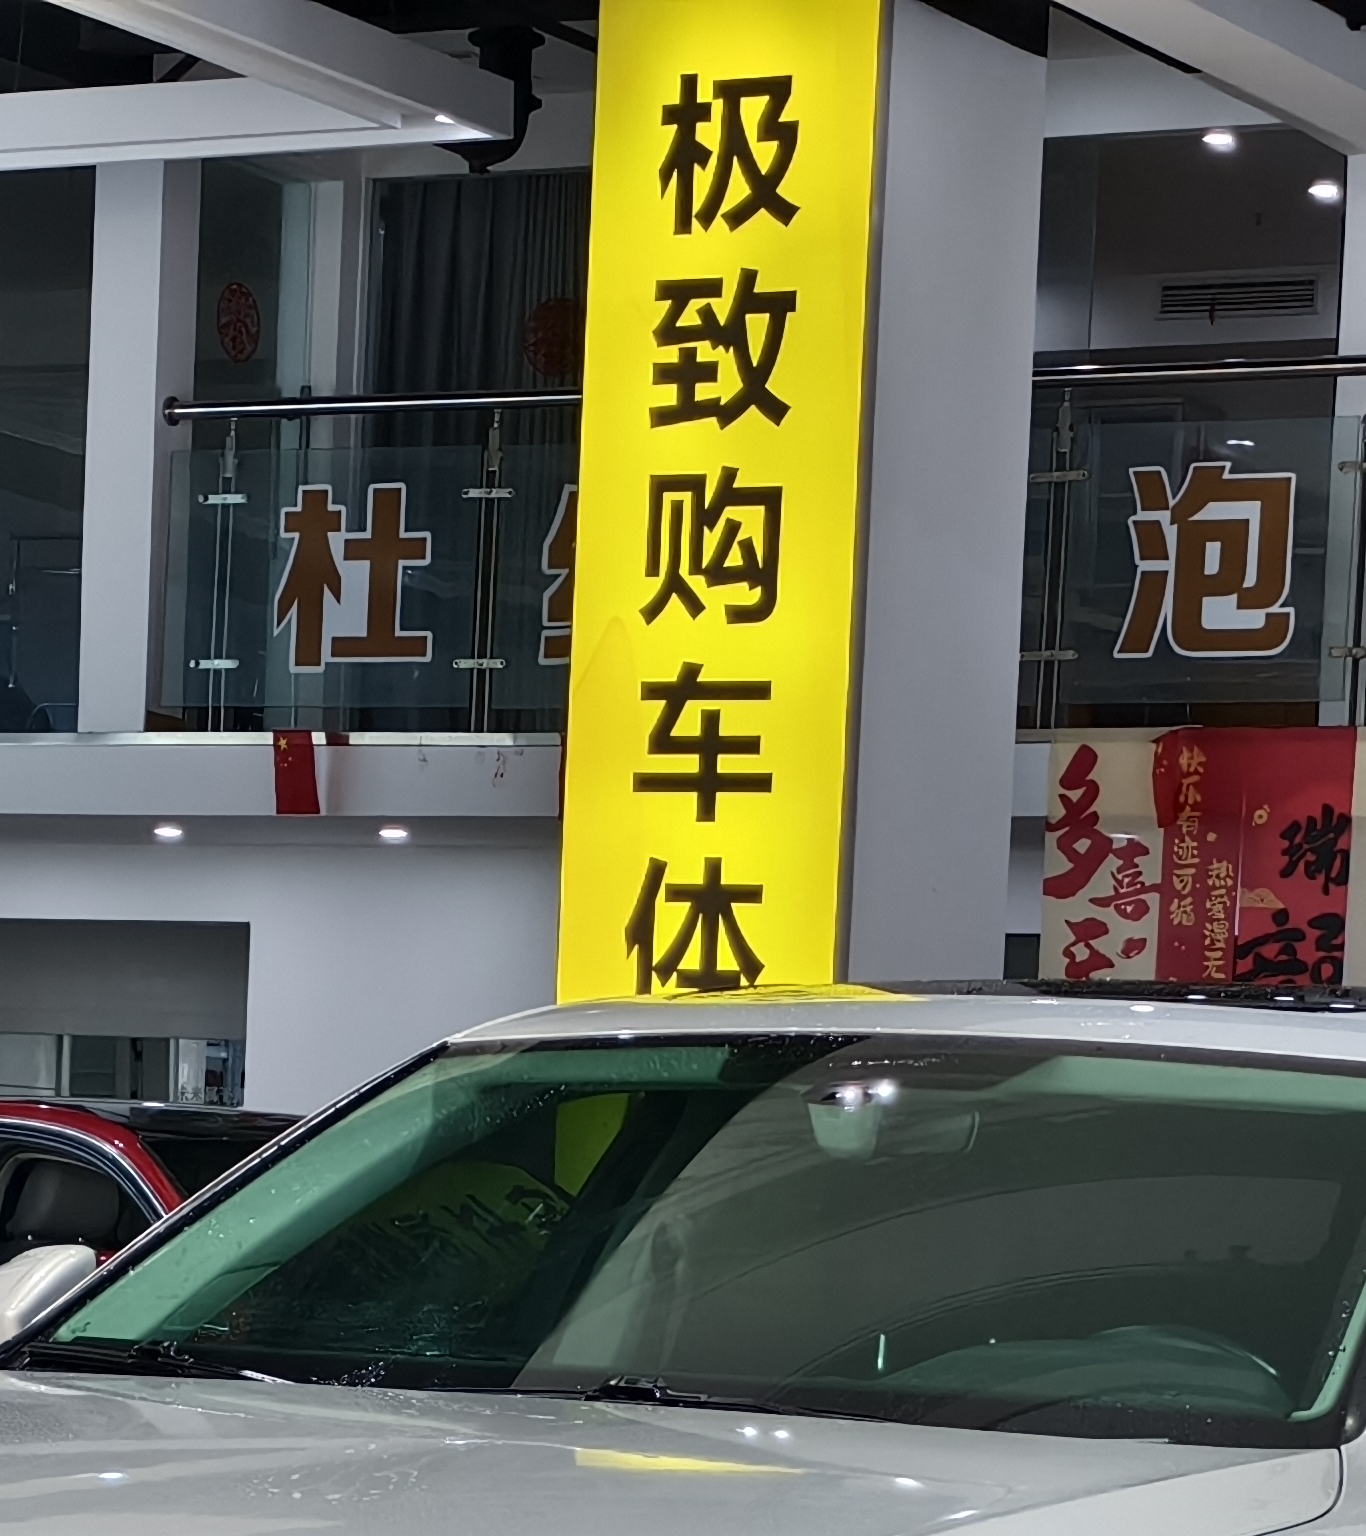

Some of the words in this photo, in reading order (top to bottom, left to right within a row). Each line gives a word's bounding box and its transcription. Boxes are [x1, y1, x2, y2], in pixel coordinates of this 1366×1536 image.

[273, 481, 579, 669] 杜
[624, 72, 801, 995] 极致购车体
[1170, 745, 1206, 927] 快乐有迹可循
